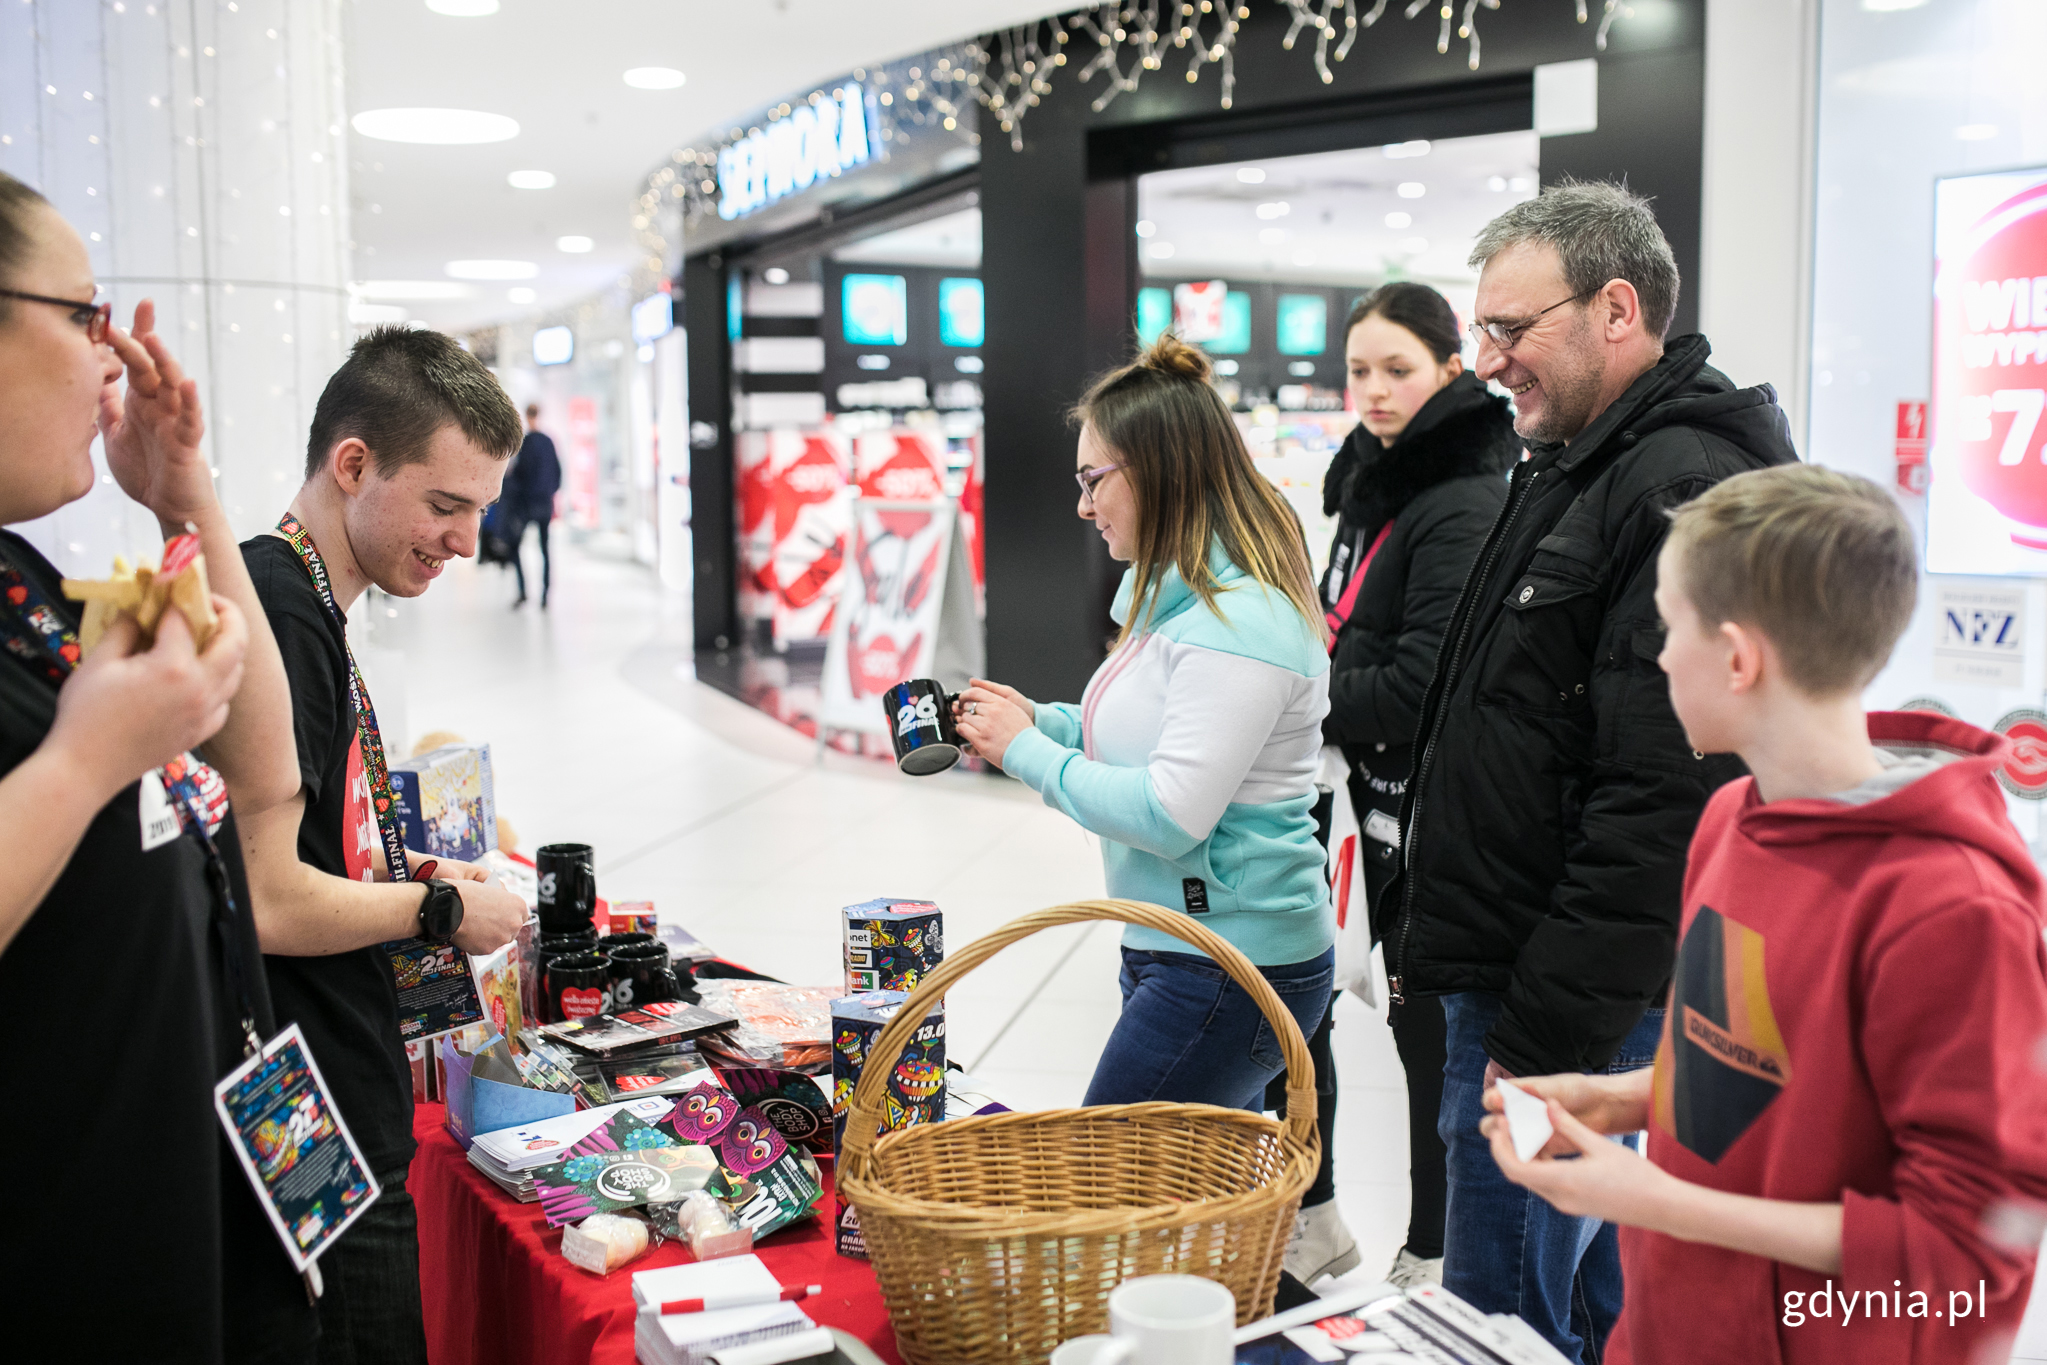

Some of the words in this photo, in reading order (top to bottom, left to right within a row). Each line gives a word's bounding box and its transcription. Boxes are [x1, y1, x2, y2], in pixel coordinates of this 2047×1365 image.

[1944, 606, 2021, 649] NFZ
[897, 693, 938, 737] 26
[538, 871, 557, 897] 6
[420, 946, 455, 977] 27
[769, 1112, 783, 1129] THE
[777, 1107, 800, 1133] BODY
[789, 1107, 811, 1131] SHOP
[610, 1167, 651, 1180] SHOP
[612, 1173, 656, 1187] BODY
[624, 1180, 650, 1191] THE
